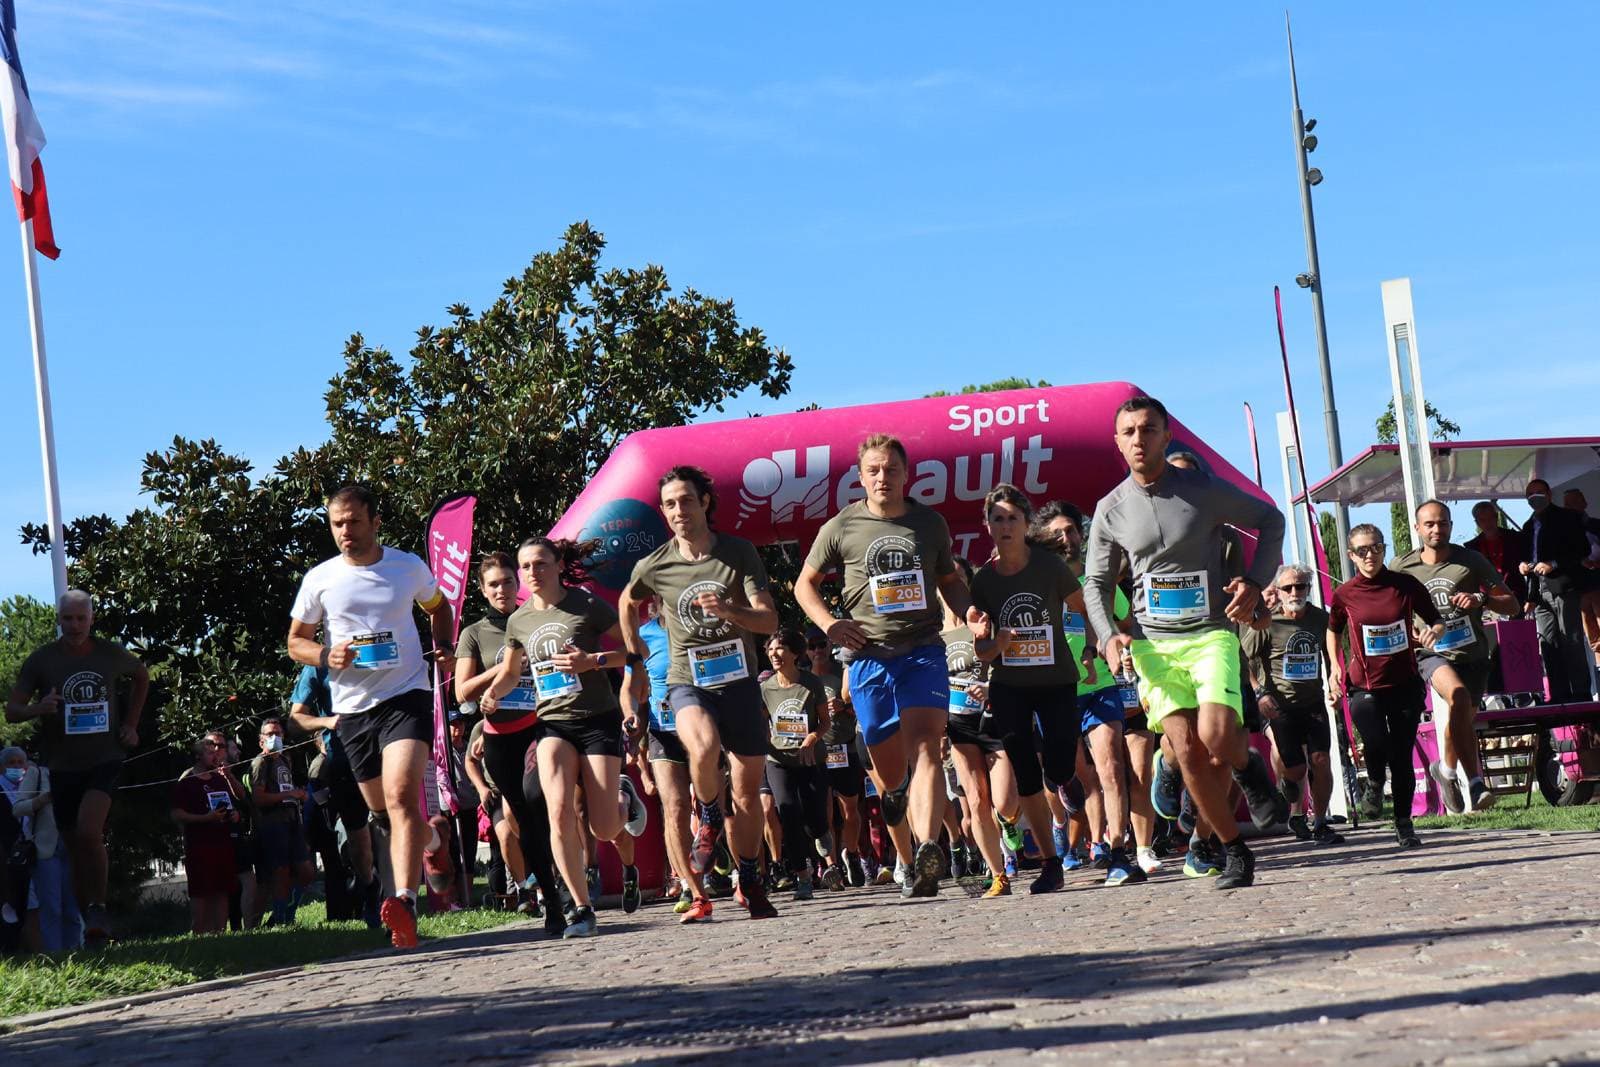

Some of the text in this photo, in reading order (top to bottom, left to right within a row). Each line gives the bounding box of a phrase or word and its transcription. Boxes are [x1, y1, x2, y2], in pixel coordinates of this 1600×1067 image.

[948, 399, 1049, 437] Sport
[886, 551, 903, 569] 10
[1195, 590, 1204, 604] 2
[1433, 592, 1449, 606] 10
[1016, 612, 1034, 627] 10
[698, 627, 713, 638] LE
[390, 645, 397, 657] 3
[542, 639, 558, 657] 10
[1299, 643, 1310, 654] 10
[737, 656, 743, 667] 1
[952, 656, 966, 672] 10
[79, 685, 93, 700] 10
[94, 715, 106, 725] 10
